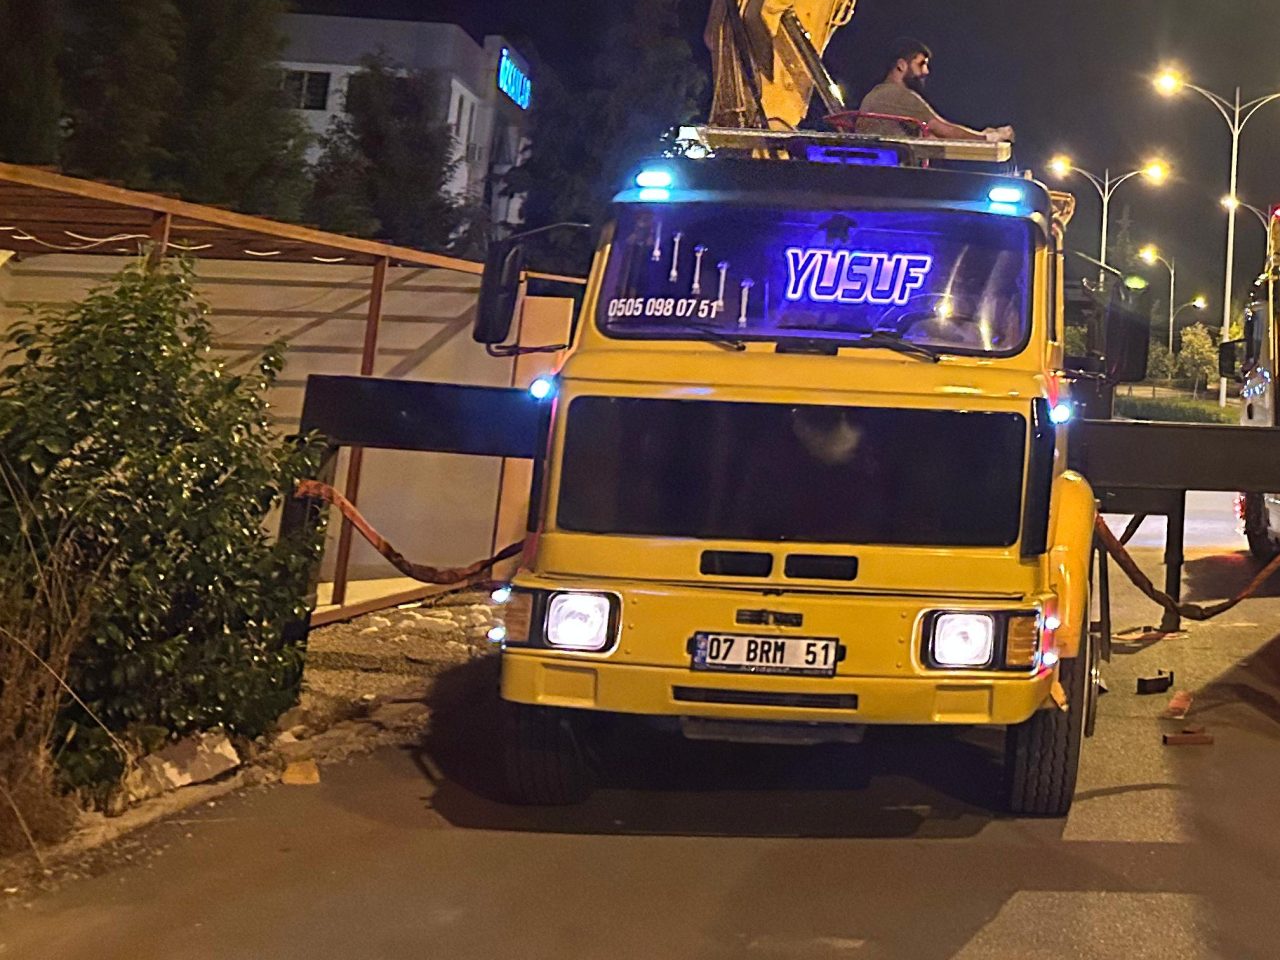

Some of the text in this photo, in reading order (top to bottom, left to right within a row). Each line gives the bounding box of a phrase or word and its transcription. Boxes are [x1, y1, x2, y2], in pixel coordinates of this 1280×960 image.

[786, 247, 932, 306] YUSUF
[608, 297, 719, 319] 0505 098 07 51
[709, 637, 831, 666] 07 BRM 51
